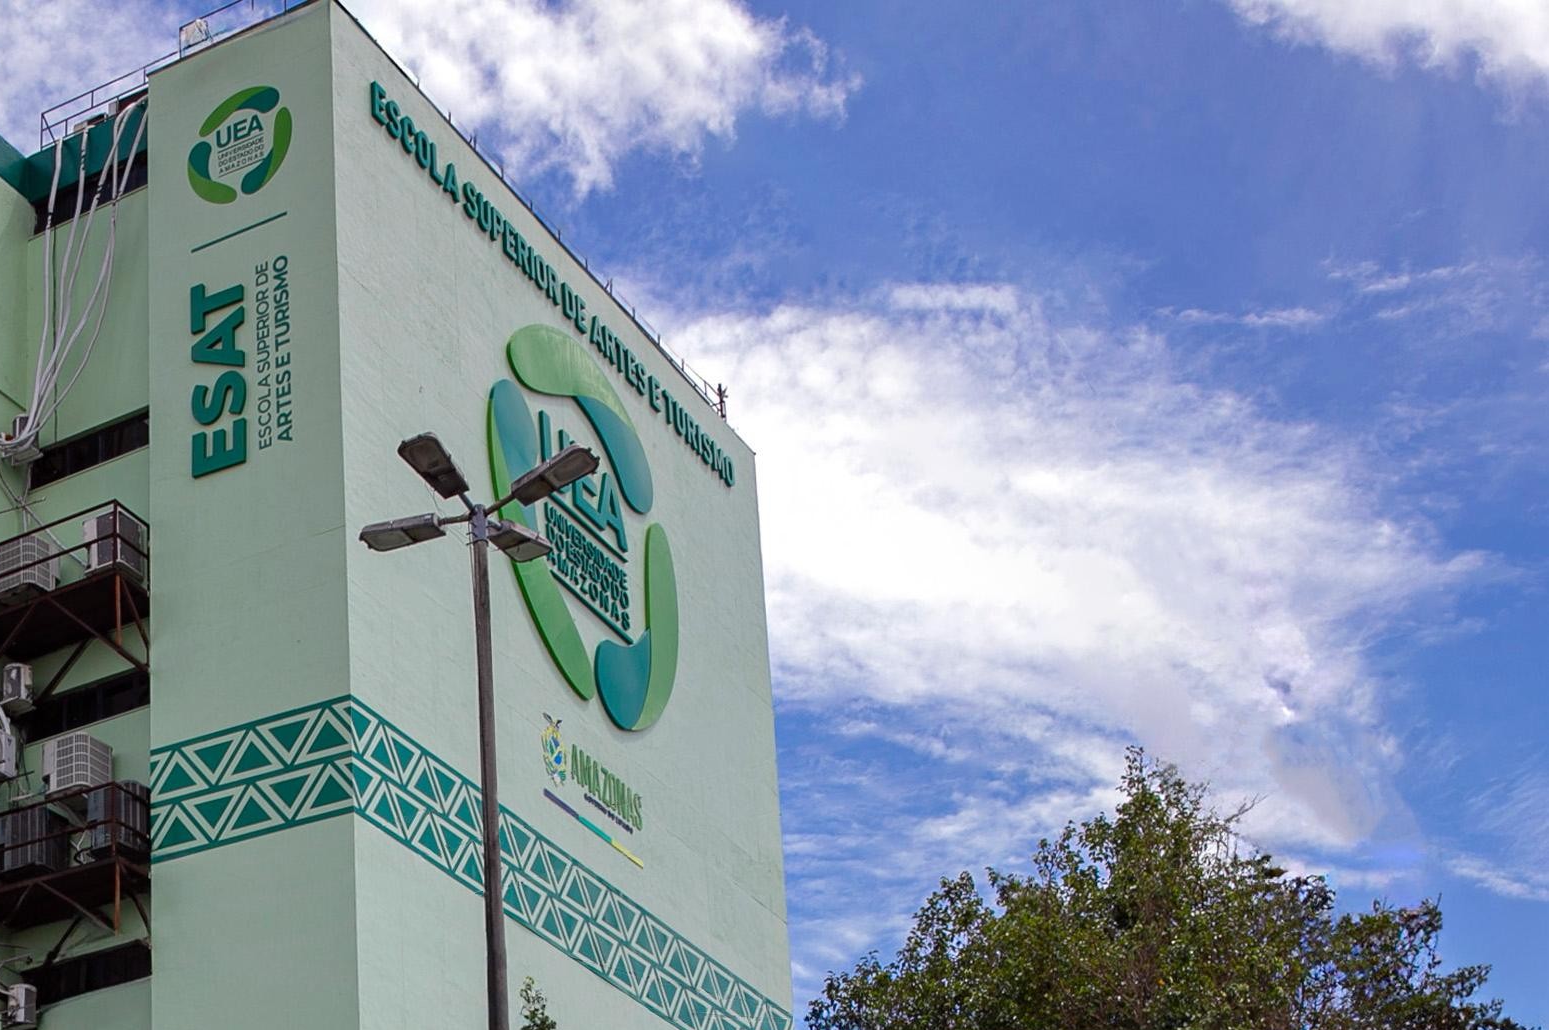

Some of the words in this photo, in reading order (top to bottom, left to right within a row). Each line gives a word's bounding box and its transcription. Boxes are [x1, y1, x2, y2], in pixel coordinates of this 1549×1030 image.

[216, 114, 264, 148] UEA
[218, 136, 264, 160] UNIVERSIDADE
[219, 151, 264, 174] AMAZONAS
[228, 148, 254, 163] ESTADO
[254, 143, 264, 152] DO
[255, 261, 269, 287] DE
[273, 255, 291, 351] TURISMO
[370, 80, 460, 203] ESCOLA
[462, 181, 561, 307] SUPERIOR
[560, 281, 588, 334] DE
[590, 314, 647, 397] ARTES
[647, 374, 661, 413] E
[662, 389, 737, 488] TURISMO
[256, 288, 271, 373] SUPERIOR
[275, 352, 291, 369] E
[191, 282, 247, 479] ESAT
[257, 373, 272, 450] ESCOLA
[275, 370, 293, 441] ARTES
[544, 502, 628, 591] UNIVERSIDADE
[546, 523, 565, 553] DO
[565, 540, 610, 592] ESTADO
[610, 580, 629, 610] DO
[547, 550, 631, 631] AMAZONAS
[571, 744, 642, 831] AMAZONAS
